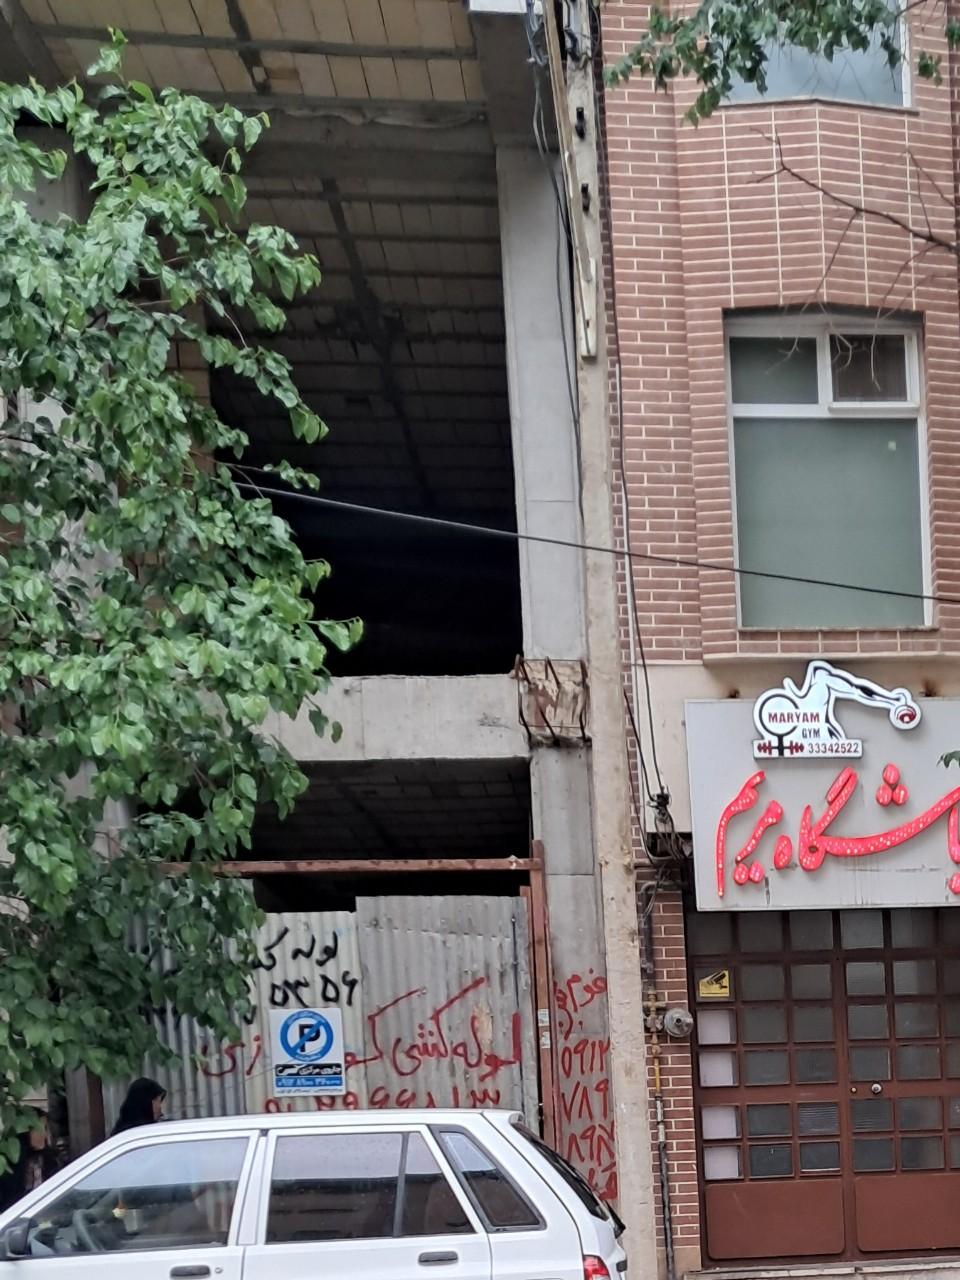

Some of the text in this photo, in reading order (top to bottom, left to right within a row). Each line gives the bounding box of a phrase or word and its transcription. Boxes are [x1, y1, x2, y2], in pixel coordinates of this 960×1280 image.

[768, 711, 820, 724] MARYAM
[801, 728, 820, 739] GYM
[807, 742, 859, 754] 33342522
